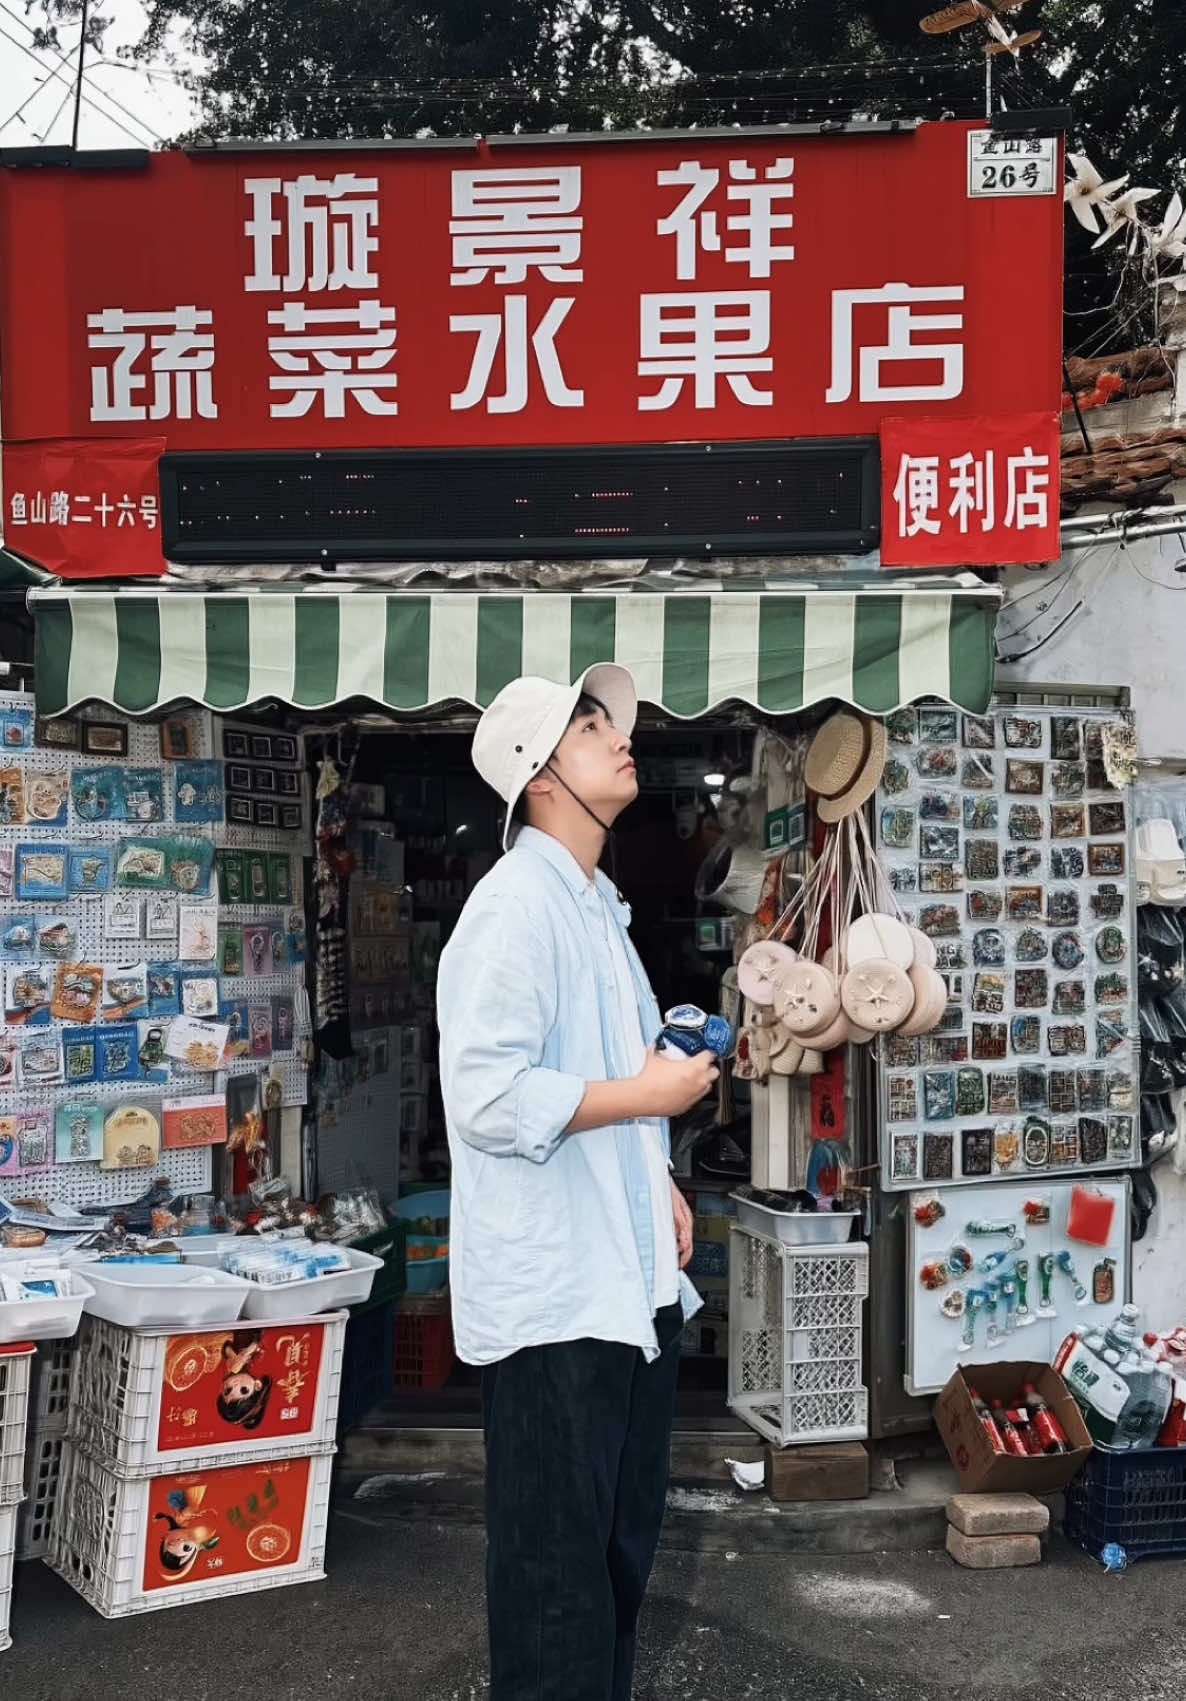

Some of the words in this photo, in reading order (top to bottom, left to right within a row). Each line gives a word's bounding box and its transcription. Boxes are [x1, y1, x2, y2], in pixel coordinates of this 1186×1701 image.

[981, 162, 1040, 189] 26号
[244, 157, 795, 292] 璇景祥
[87, 284, 966, 422] 蔬菜水果店
[11, 490, 158, 530] 鱼山路二十六号
[893, 446, 1050, 538] 便利店
